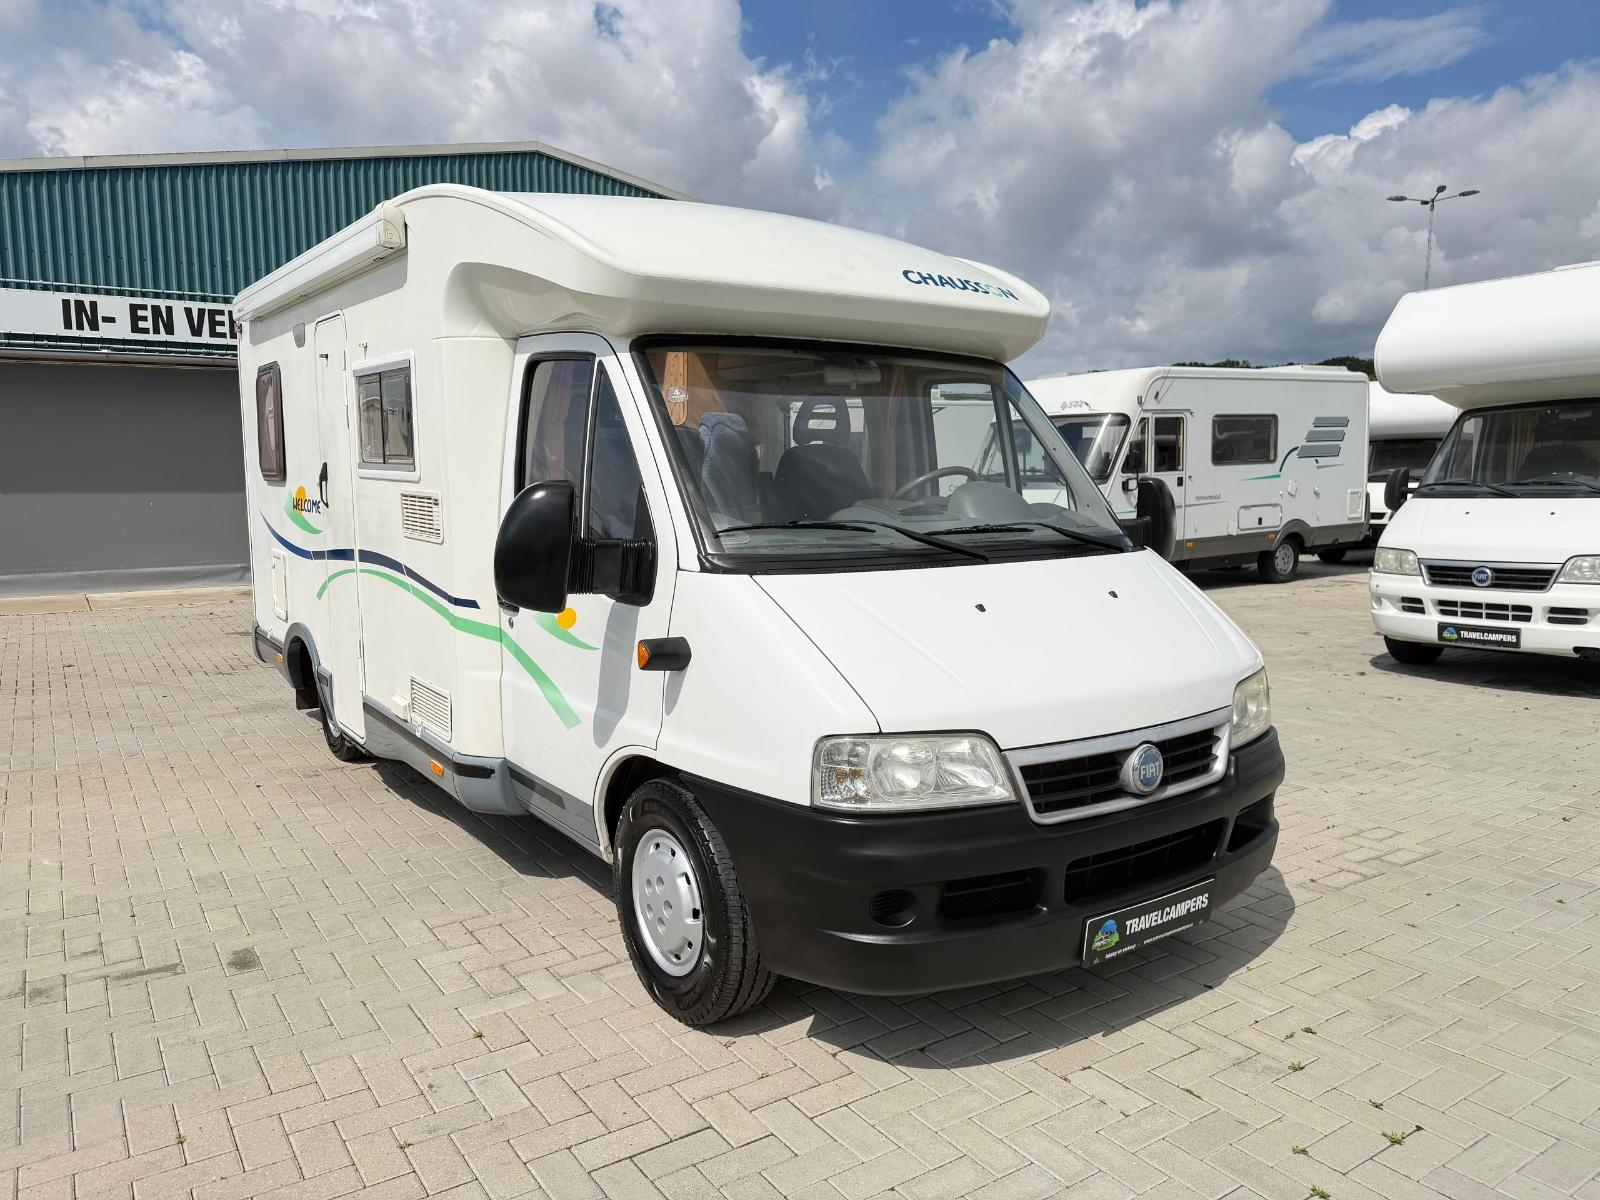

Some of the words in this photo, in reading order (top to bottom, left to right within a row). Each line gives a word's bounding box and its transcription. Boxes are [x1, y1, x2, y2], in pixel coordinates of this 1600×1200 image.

[902, 269, 1019, 301] CHAUSSON
[61, 298, 116, 331] IN-
[129, 303, 175, 335] EN
[292, 497, 321, 514] WELCOME
[1460, 631, 1517, 643] TRAVELCAMPERS
[1140, 761, 1160, 780] FIAT
[1125, 893, 1209, 935] TRAVELCAMPERS
